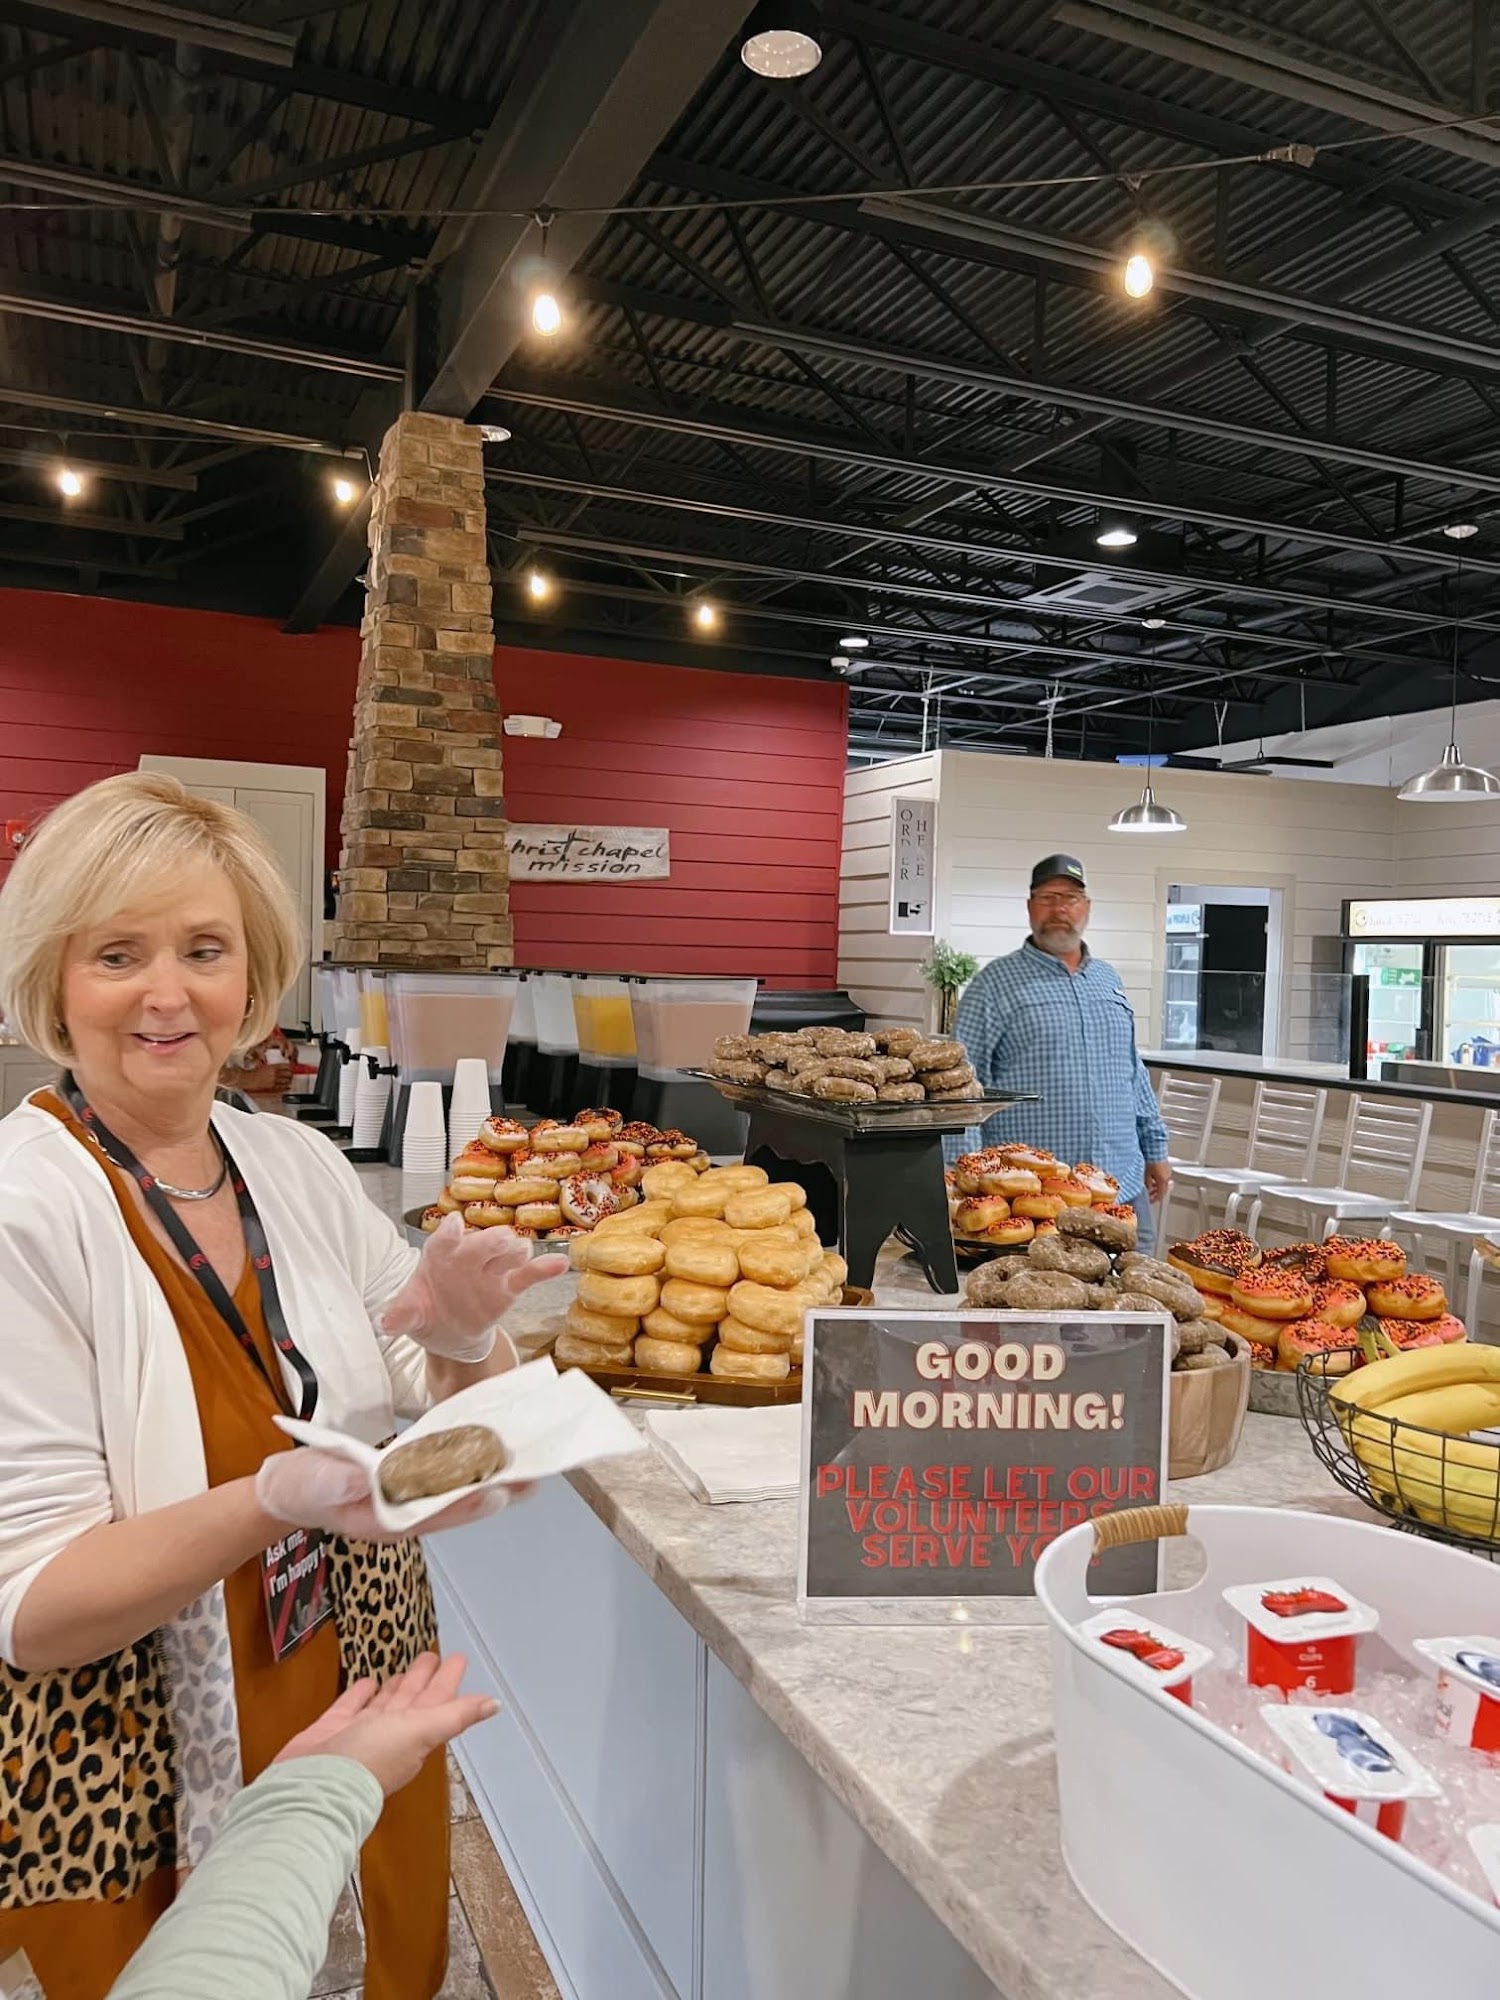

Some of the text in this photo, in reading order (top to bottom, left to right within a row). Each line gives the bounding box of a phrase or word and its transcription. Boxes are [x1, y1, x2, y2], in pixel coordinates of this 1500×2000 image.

[506, 829, 666, 861] hrist chapel
[528, 858, 642, 874] mission
[915, 1340, 1067, 1381] GOOD
[853, 1390, 1125, 1430] MORNING!
[816, 1464, 1157, 1500] PLEASE LET OUR
[266, 1530, 307, 1567] Ask me,
[861, 1535, 992, 1568] SERVE
[269, 1573, 288, 1597] I'm
[288, 1549, 318, 1582] happy
[1305, 1675, 1317, 1689] 6
